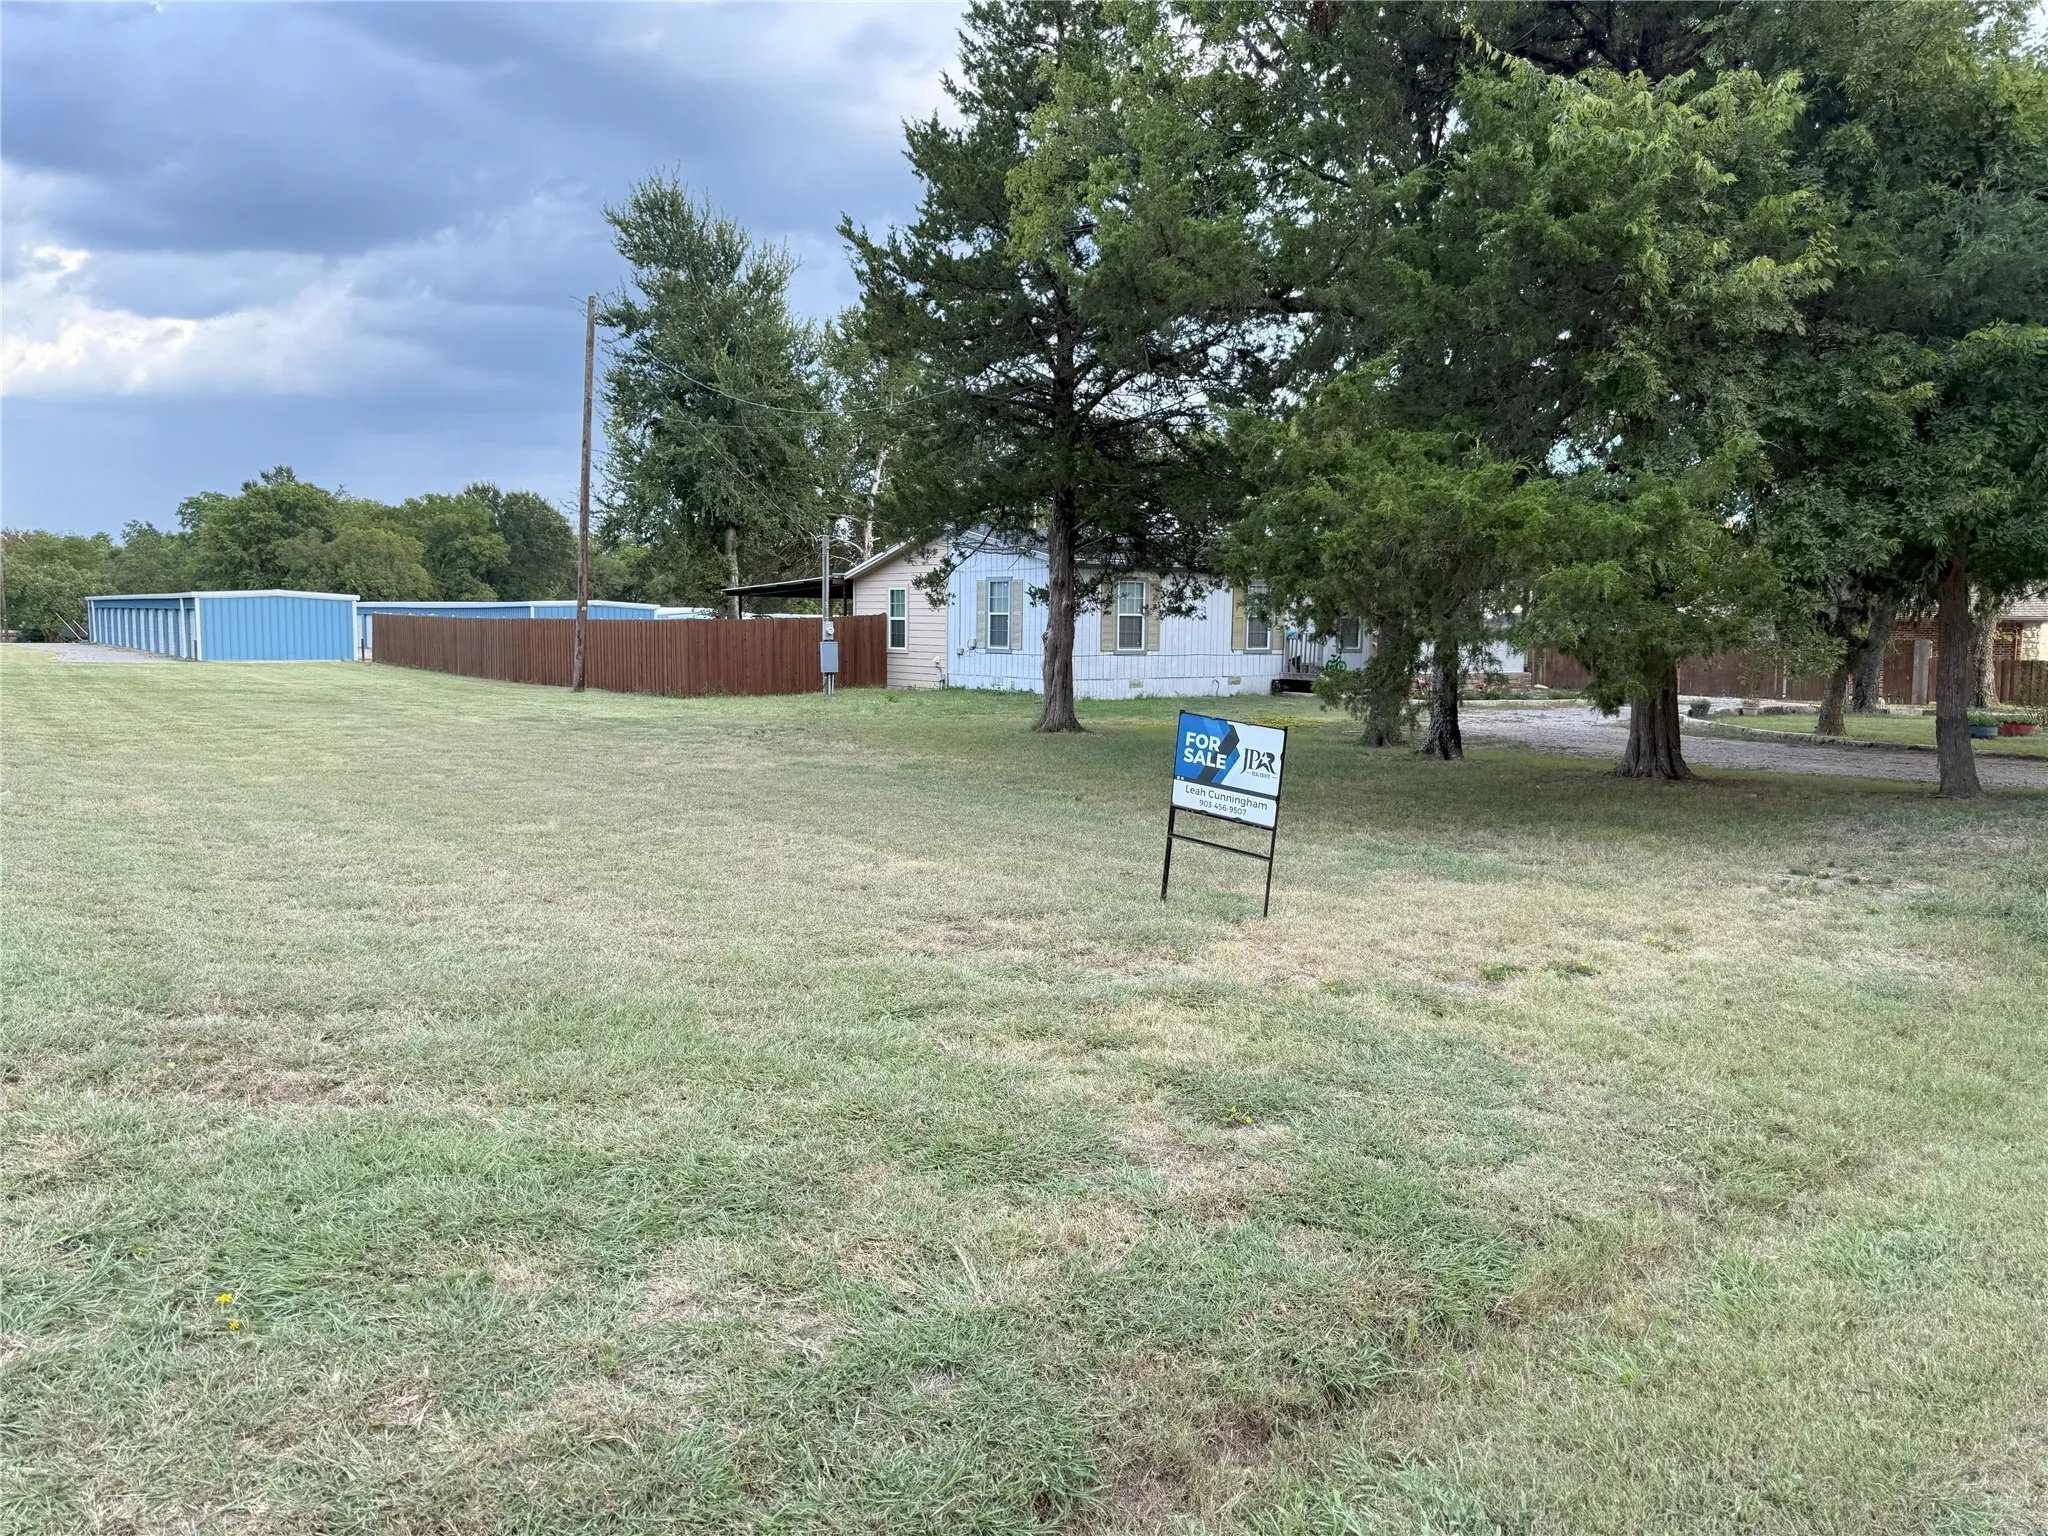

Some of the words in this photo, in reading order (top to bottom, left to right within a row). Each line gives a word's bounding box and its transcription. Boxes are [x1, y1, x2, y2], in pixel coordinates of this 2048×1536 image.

[1185, 731, 1221, 752] FOR
[1183, 747, 1228, 770] SALE
[1185, 784, 1206, 797] Leah
[1208, 789, 1268, 811] Cunningham
[1199, 799, 1247, 816] 903-456-9507
